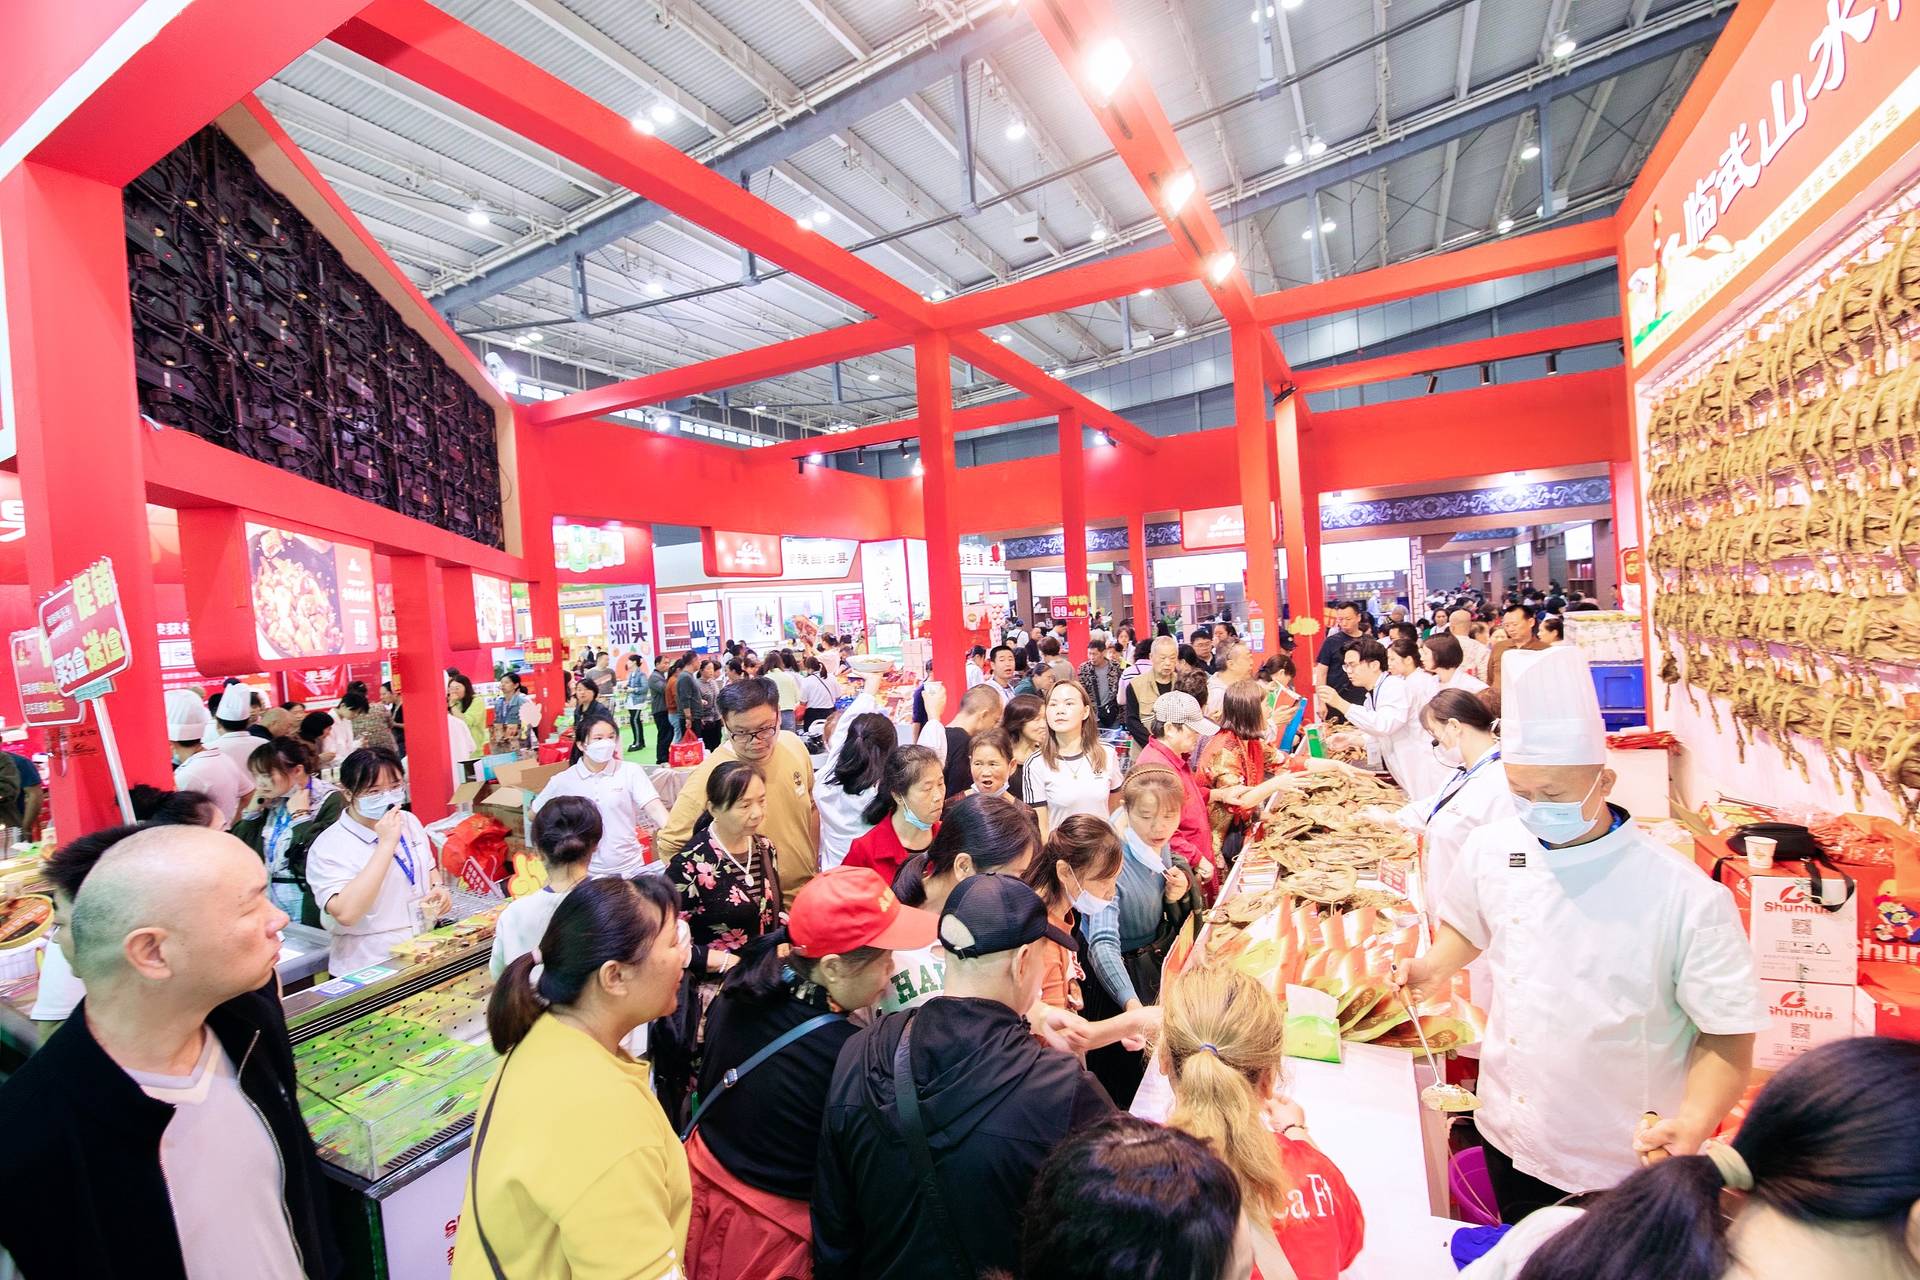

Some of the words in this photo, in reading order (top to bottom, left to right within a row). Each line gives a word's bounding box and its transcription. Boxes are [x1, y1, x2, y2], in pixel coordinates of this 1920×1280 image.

[1683, 0, 1901, 246] 临武山水
[609, 598, 646, 622] 橘子
[610, 621, 648, 644] 洲头
